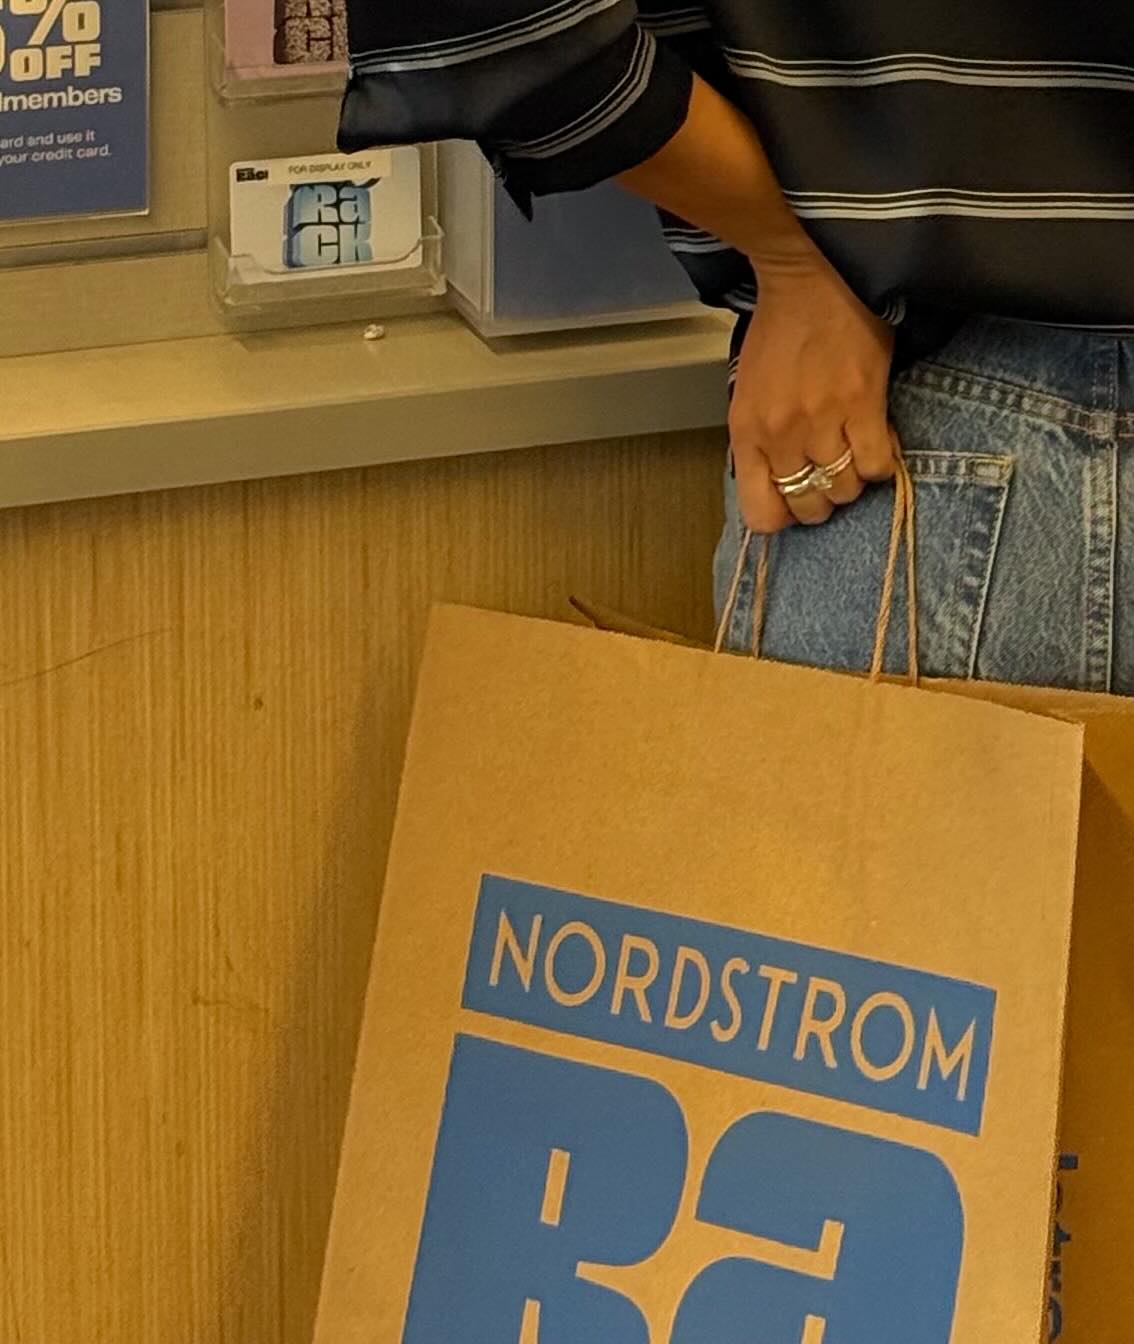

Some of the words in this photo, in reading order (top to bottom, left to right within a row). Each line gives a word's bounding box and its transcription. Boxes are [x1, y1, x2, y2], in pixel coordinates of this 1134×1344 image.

[10, 43, 101, 82] OFF
[0, 85, 123, 113] members
[0, 134, 24, 150] ard
[27, 132, 54, 148] and
[57, 131, 83, 145] use
[85, 128, 96, 142] it
[31, 146, 73, 163] credit
[488, 908, 977, 1102] NORDSTROM
